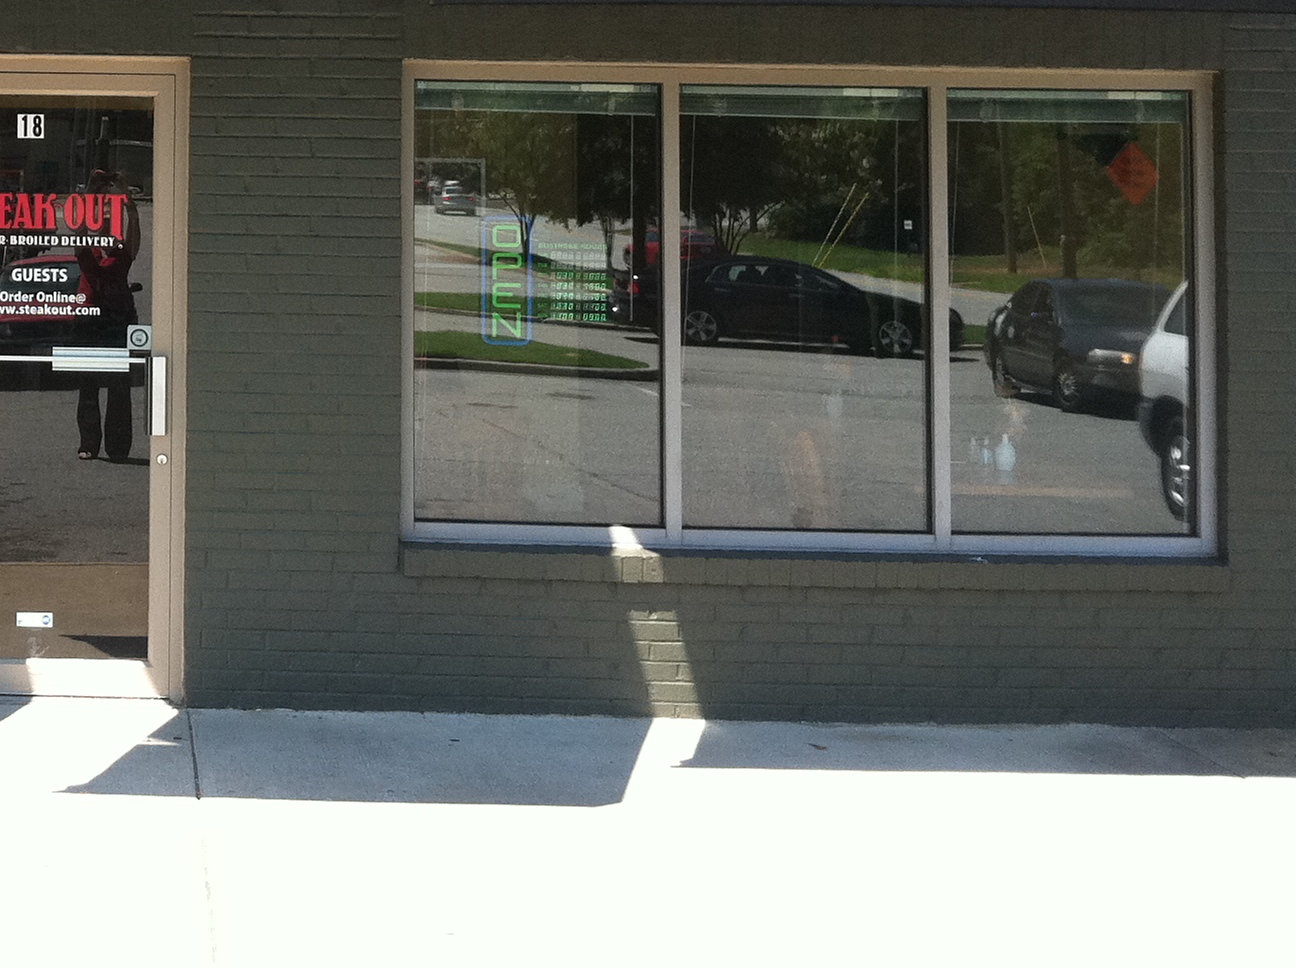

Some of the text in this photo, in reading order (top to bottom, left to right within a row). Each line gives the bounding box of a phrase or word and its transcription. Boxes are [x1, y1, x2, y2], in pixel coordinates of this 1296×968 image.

[20, 114, 43, 138] 18
[60, 236, 115, 247] DELIVERY
[11, 267, 68, 283] GUESTS
[491, 224, 523, 339] OPEN
[0, 291, 34, 303] Order
